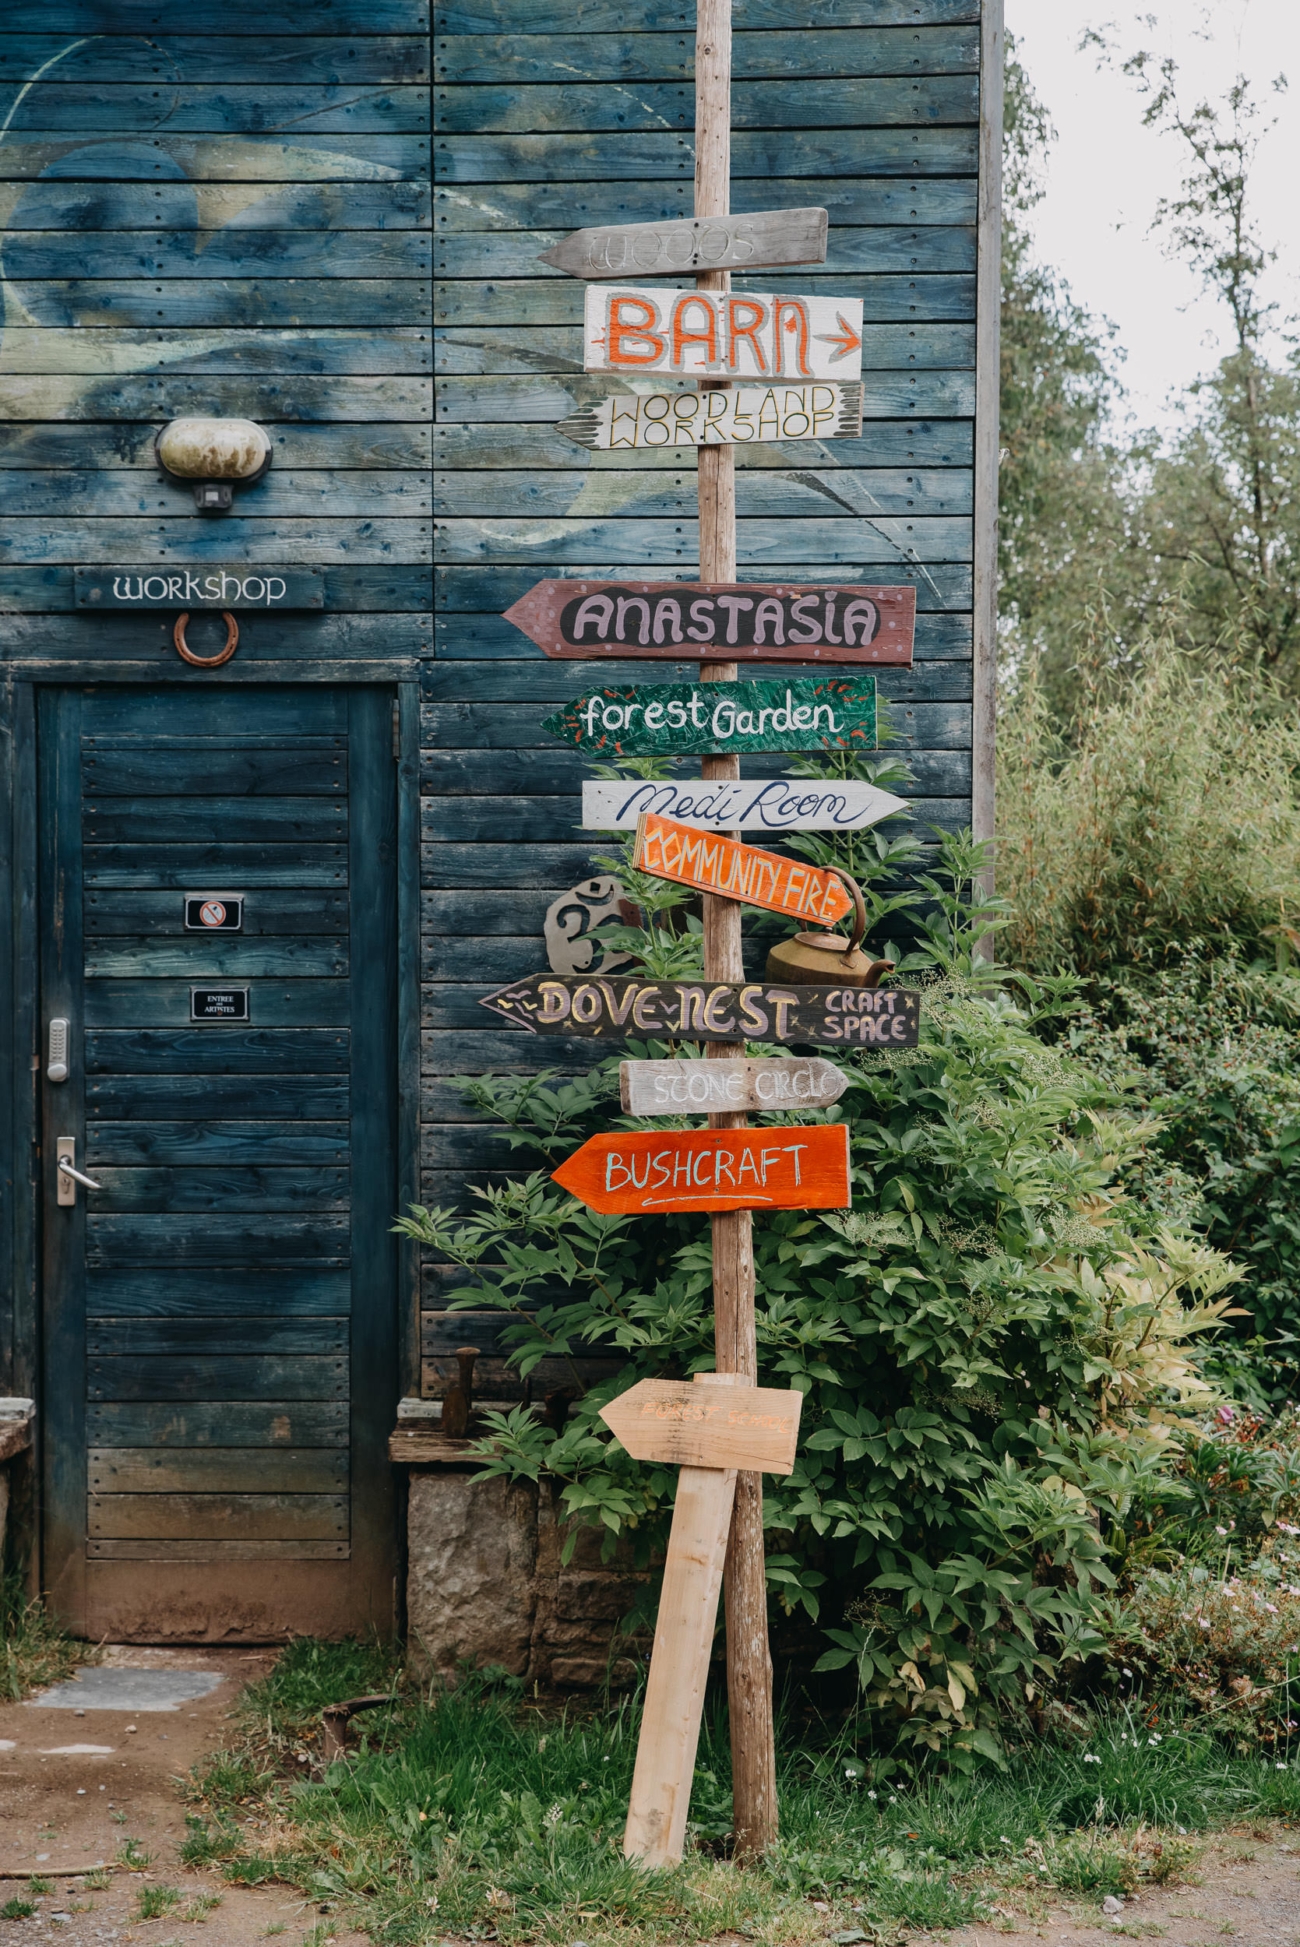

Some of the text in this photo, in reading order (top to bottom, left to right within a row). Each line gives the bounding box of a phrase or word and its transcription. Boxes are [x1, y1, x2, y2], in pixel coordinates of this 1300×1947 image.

[609, 386, 836, 424] WOODLAND
[609, 411, 835, 448] WORKSHOP
[112, 571, 287, 606] workshop
[579, 689, 844, 739] forest Garden
[615, 780, 873, 828] Medi Room
[642, 825, 841, 919] COMMUNITY FIRE
[537, 980, 663, 1030] DOVE
[824, 990, 900, 1014] CRAFT
[820, 1014, 908, 1042] SPACE
[653, 1063, 840, 1103] STONE CIRCLE
[605, 1144, 809, 1192] BUSHCRAFT
[641, 1402, 790, 1434] FOREST SCHOOL
